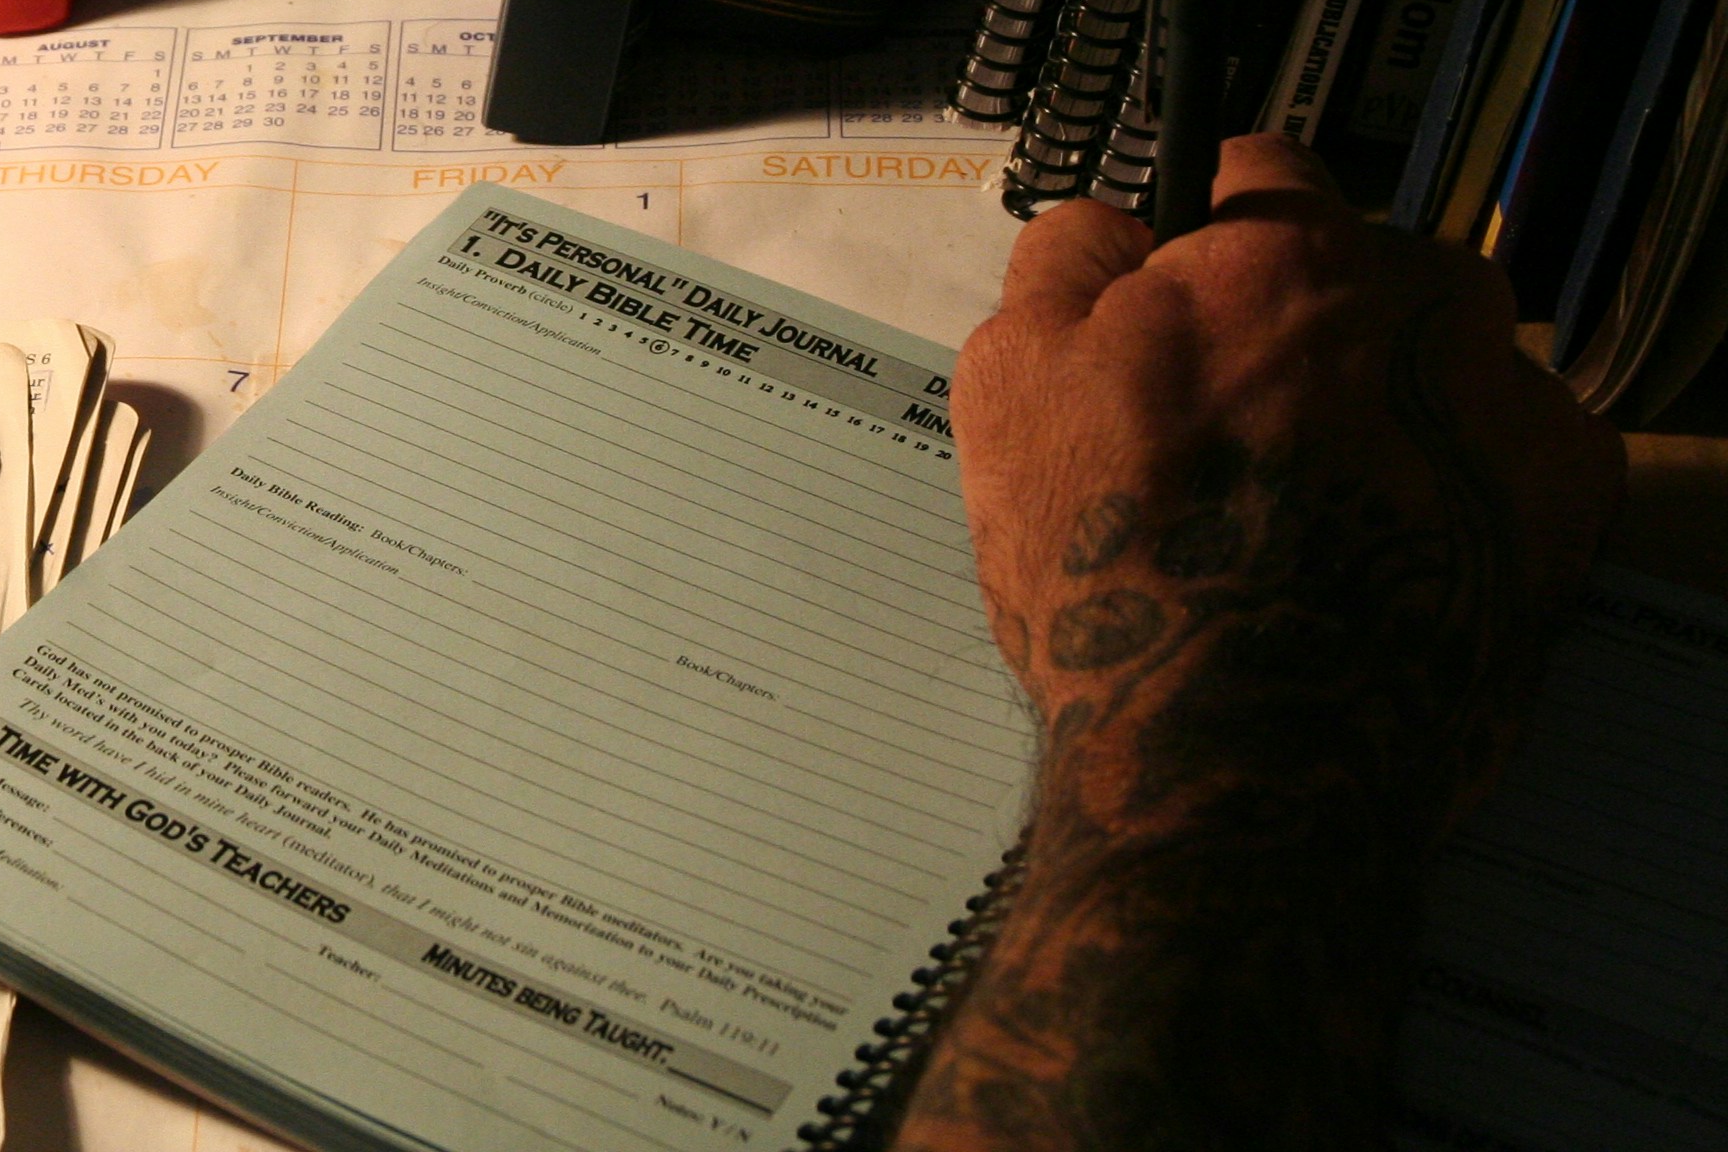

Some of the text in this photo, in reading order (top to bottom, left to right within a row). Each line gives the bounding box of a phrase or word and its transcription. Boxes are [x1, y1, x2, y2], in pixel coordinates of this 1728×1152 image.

[38, 39, 111, 52] AUGUST
[231, 34, 345, 46] SEPTEMBER
[459, 32, 495, 42] OCT
[412, 157, 568, 189] FRIDAY
[762, 153, 990, 182] SATURDAY
[636, 192, 650, 210] 1
[438, 255, 574, 314] Daily Proverb (circle)
[460, 235, 482, 258] 1.
[494, 250, 589, 293] DAILY
[585, 282, 680, 332] BIBLE
[684, 317, 760, 363] TIME
[417, 277, 602, 356] Insight/Conviction/Application
[683, 285, 764, 329] DAILY
[758, 318, 878, 378] JOURNAL
[226, 369, 252, 394] 7
[210, 485, 400, 575] Insight/Conviction/Application
[230, 467, 469, 577] Daily Bible Reading: Book/Chapters:
[37, 644, 351, 812] God has not promised to prosper Bible readers.
[56, 763, 127, 811] WITH
[124, 798, 211, 854] GOD'S
[209, 838, 352, 924] TEACHERS
[422, 943, 518, 998] MINUTES
[514, 987, 582, 1026] BEING
